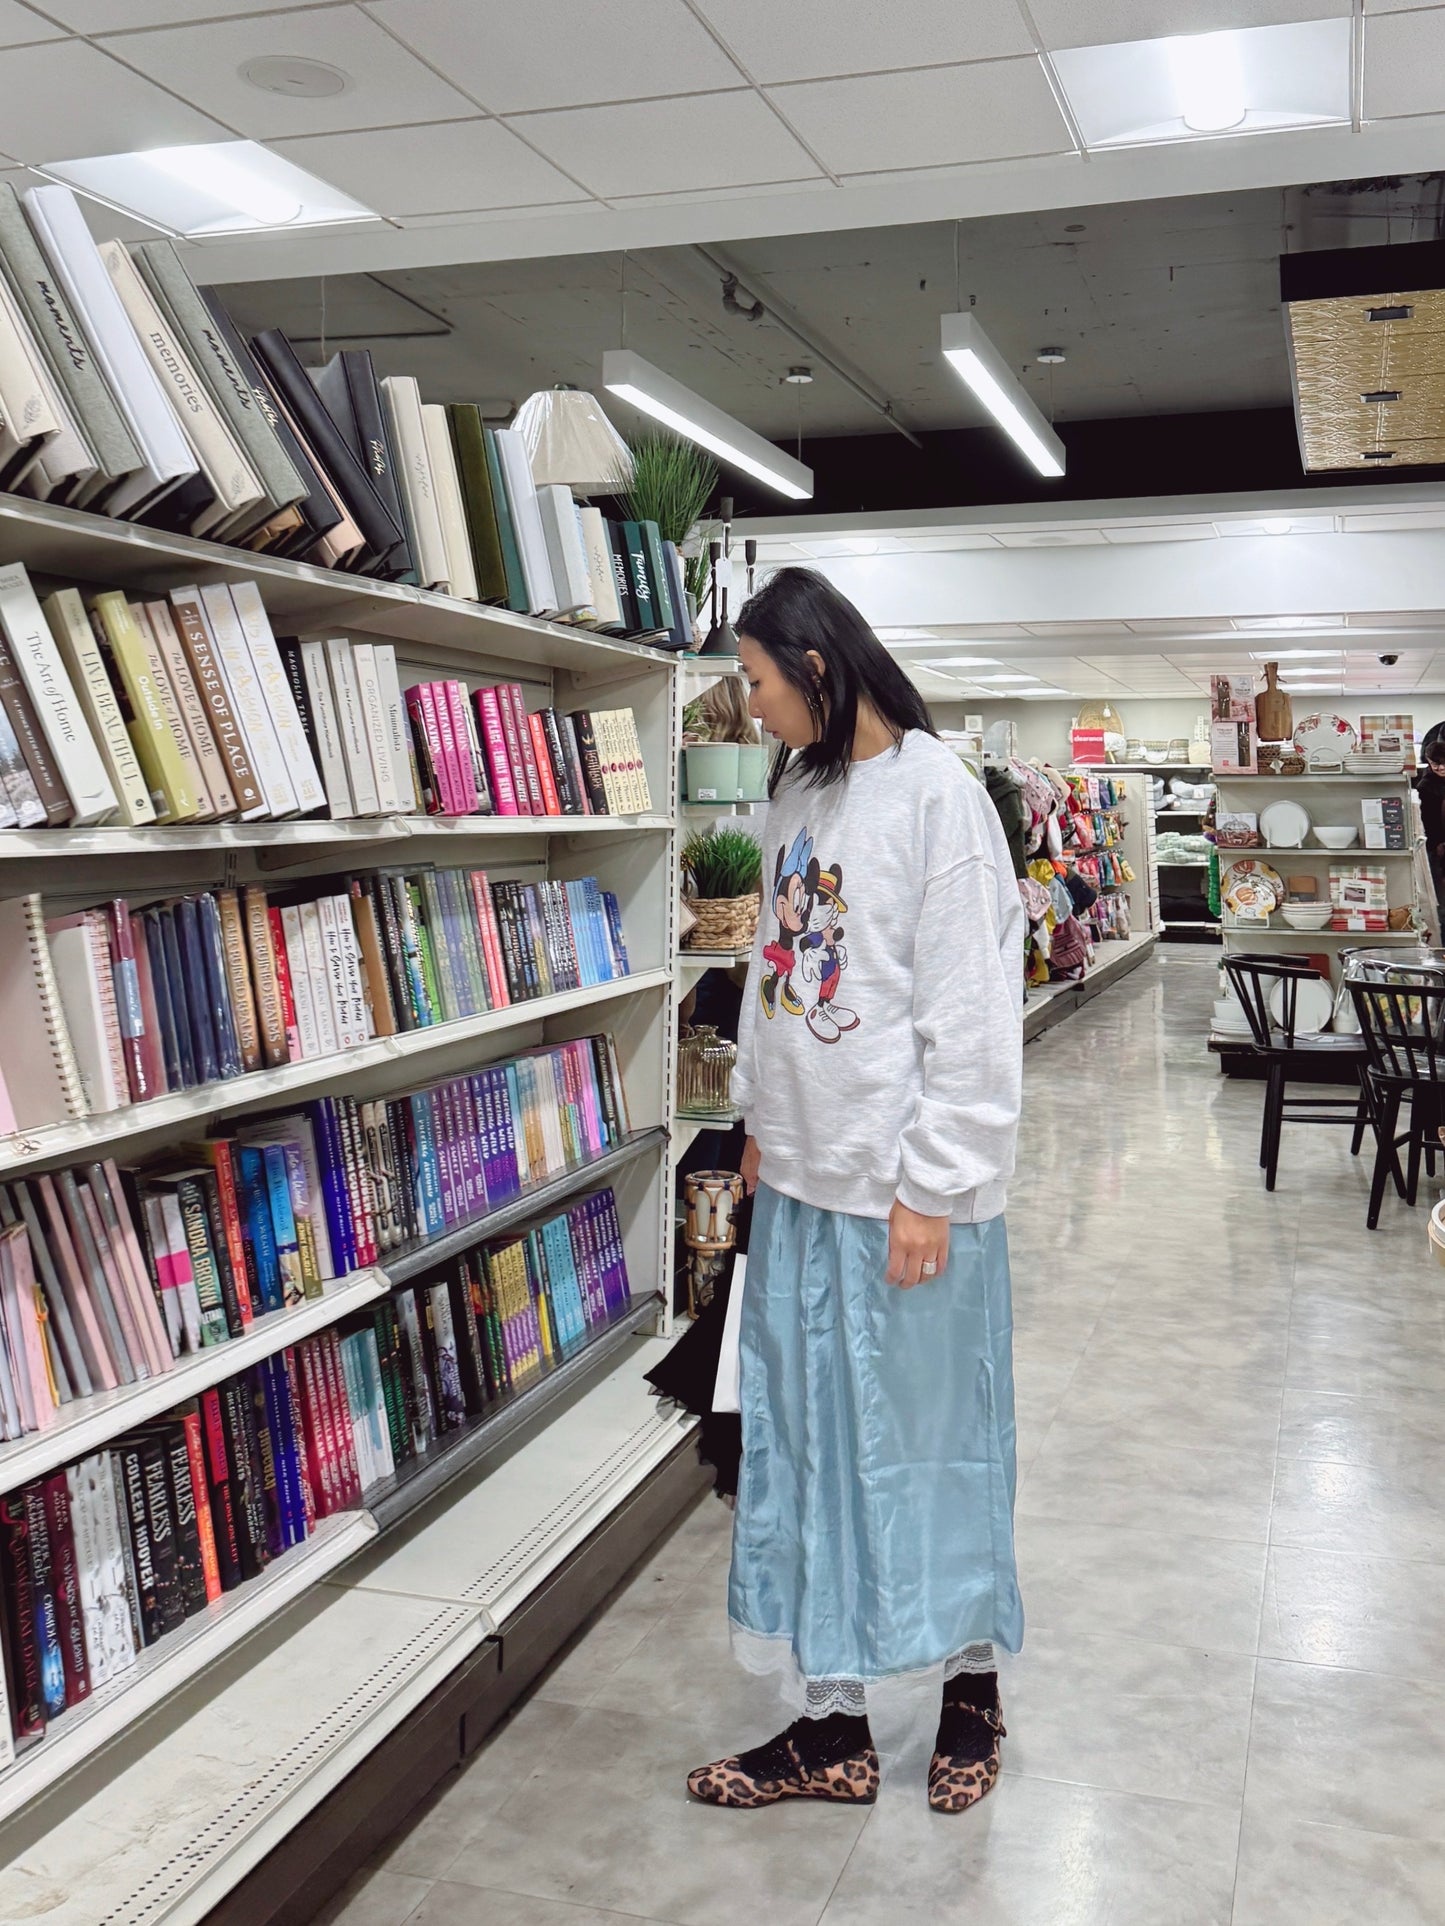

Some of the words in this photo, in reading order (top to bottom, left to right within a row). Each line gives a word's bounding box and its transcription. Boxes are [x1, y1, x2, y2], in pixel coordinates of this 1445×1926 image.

[37, 279, 86, 372] moments
[150, 331, 204, 414] memories
[202, 329, 251, 409] moments
[613, 553, 630, 596] MEMORIES
[25, 631, 46, 660] The
[189, 630, 220, 691] SENSE
[36, 660, 55, 684] Art
[42, 683, 62, 701] of
[152, 668, 172, 705] LOVE
[175, 665, 196, 703] LOVE
[287, 650, 303, 700] MAGNOLIA
[298, 704, 309, 733] TABLE
[51, 698, 78, 743] Home
[81, 650, 106, 690] LIVE
[95, 691, 139, 786] BEAUTIFUL
[137, 674, 161, 718] Outside
[152, 718, 165, 730] In
[165, 706, 176, 716] of
[188, 703, 199, 714] of
[210, 692, 229, 718] OF
[451, 693, 468, 750] INVITATION
[481, 692, 497, 718] HAPPY
[168, 716, 191, 760] HOME
[191, 714, 214, 757] HOME
[363, 678, 385, 742] ORGANIZED
[375, 745, 391, 783] LIVING
[388, 703, 402, 751] Minimalista
[423, 697, 441, 754] INVITATION
[436, 695, 455, 752] INVITATION
[486, 718, 502, 744] PLACE
[218, 720, 250, 779] PLACE
[492, 750, 507, 775] EMILY
[526, 763, 535, 777] ALLY
[497, 776, 513, 804] HENRY
[513, 764, 522, 778] ALLY
[515, 778, 527, 802] CARTER
[528, 777, 539, 800] CARTER
[223, 910, 238, 945] FOUR
[249, 904, 265, 940] FOUR
[325, 930, 337, 945] How
[340, 928, 352, 942] How
[378, 884, 392, 921] BRISTOL
[386, 925, 399, 954] KEATS
[229, 948, 247, 996] RUINED
[254, 943, 273, 992] RUINED
[347, 979, 359, 994] Your
[296, 981, 306, 1009] MARNI
[301, 1014, 312, 1039] MANN
[332, 982, 344, 997] Your
[351, 996, 365, 1021] Murder
[236, 998, 254, 1049] REALMS
[262, 992, 282, 1042] REALMS
[319, 1010, 329, 1035] MANN
[337, 999, 351, 1024] Murder
[454, 1100, 465, 1136] PUCKING
[460, 1139, 469, 1167] SWEET
[464, 1096, 474, 1131] PUCKING
[470, 1135, 479, 1163] SWEET
[475, 1096, 486, 1133] PUCKING
[484, 1092, 494, 1129] PUCKING
[489, 1131, 497, 1154] WILD
[492, 1089, 503, 1126] PUCKING
[498, 1128, 506, 1151] WILD
[501, 1088, 511, 1123] PUCKING
[506, 1126, 515, 1148] WILD
[417, 1119, 428, 1157] PUCKING
[423, 1161, 433, 1197] AROUND
[433, 1109, 443, 1146] PUCKING
[438, 1150, 447, 1179] SWEET
[443, 1105, 455, 1141] PUCKING
[450, 1145, 459, 1174] SWEET
[480, 1135, 490, 1158] WILD
[339, 1118, 355, 1172] HARLAN
[348, 1172, 362, 1216] COBEN
[350, 1115, 365, 1169] HARLAN
[358, 1168, 371, 1212] COBEN
[291, 1178, 310, 1209] Woods
[185, 1203, 206, 1262] SANDRA
[258, 1225, 270, 1256] WRATH
[296, 1221, 307, 1244] JENNY
[300, 1245, 312, 1276] HOLIDAY
[583, 1259, 591, 1283] SWEET
[590, 1254, 598, 1278] SWEET
[194, 1256, 217, 1308] BROWN
[464, 1307, 474, 1335] KEATS
[303, 1357, 318, 1408] APPRENTICE
[312, 1352, 327, 1402] APPRENTICE
[323, 1347, 337, 1398] APPRENTICE
[332, 1342, 345, 1393] APPRENTICE
[210, 1399, 221, 1432] RILEY
[293, 1398, 302, 1425] LAST
[323, 1413, 335, 1452] VILLAIN
[333, 1408, 345, 1446] VILLAIN
[341, 1400, 352, 1439] VILLAIN
[398, 1407, 409, 1445] BARCLAY
[226, 1391, 239, 1438] BRISTOL
[233, 1444, 245, 1480] KEATS
[297, 1430, 308, 1471] WORDS
[313, 1418, 325, 1458] VILLAIN
[388, 1414, 399, 1453] BARCLAY
[215, 1437, 227, 1475] SAGER
[125, 1453, 147, 1528] COLLEEN
[144, 1460, 172, 1543] FEARLESS
[169, 1444, 197, 1527] FEARLESS
[34, 1495, 51, 1567] JENNIFER
[52, 1490, 64, 1530] BOLEYN
[225, 1503, 233, 1523] ONLY
[246, 1503, 255, 1543] PEARSON
[25, 1493, 44, 1586] ARMENTROUT
[135, 1524, 156, 1592] HOOVER
[61, 1563, 76, 1603] WINGS
[42, 1593, 57, 1656] OBSIDIAN
[22, 1644, 38, 1688] DARK
